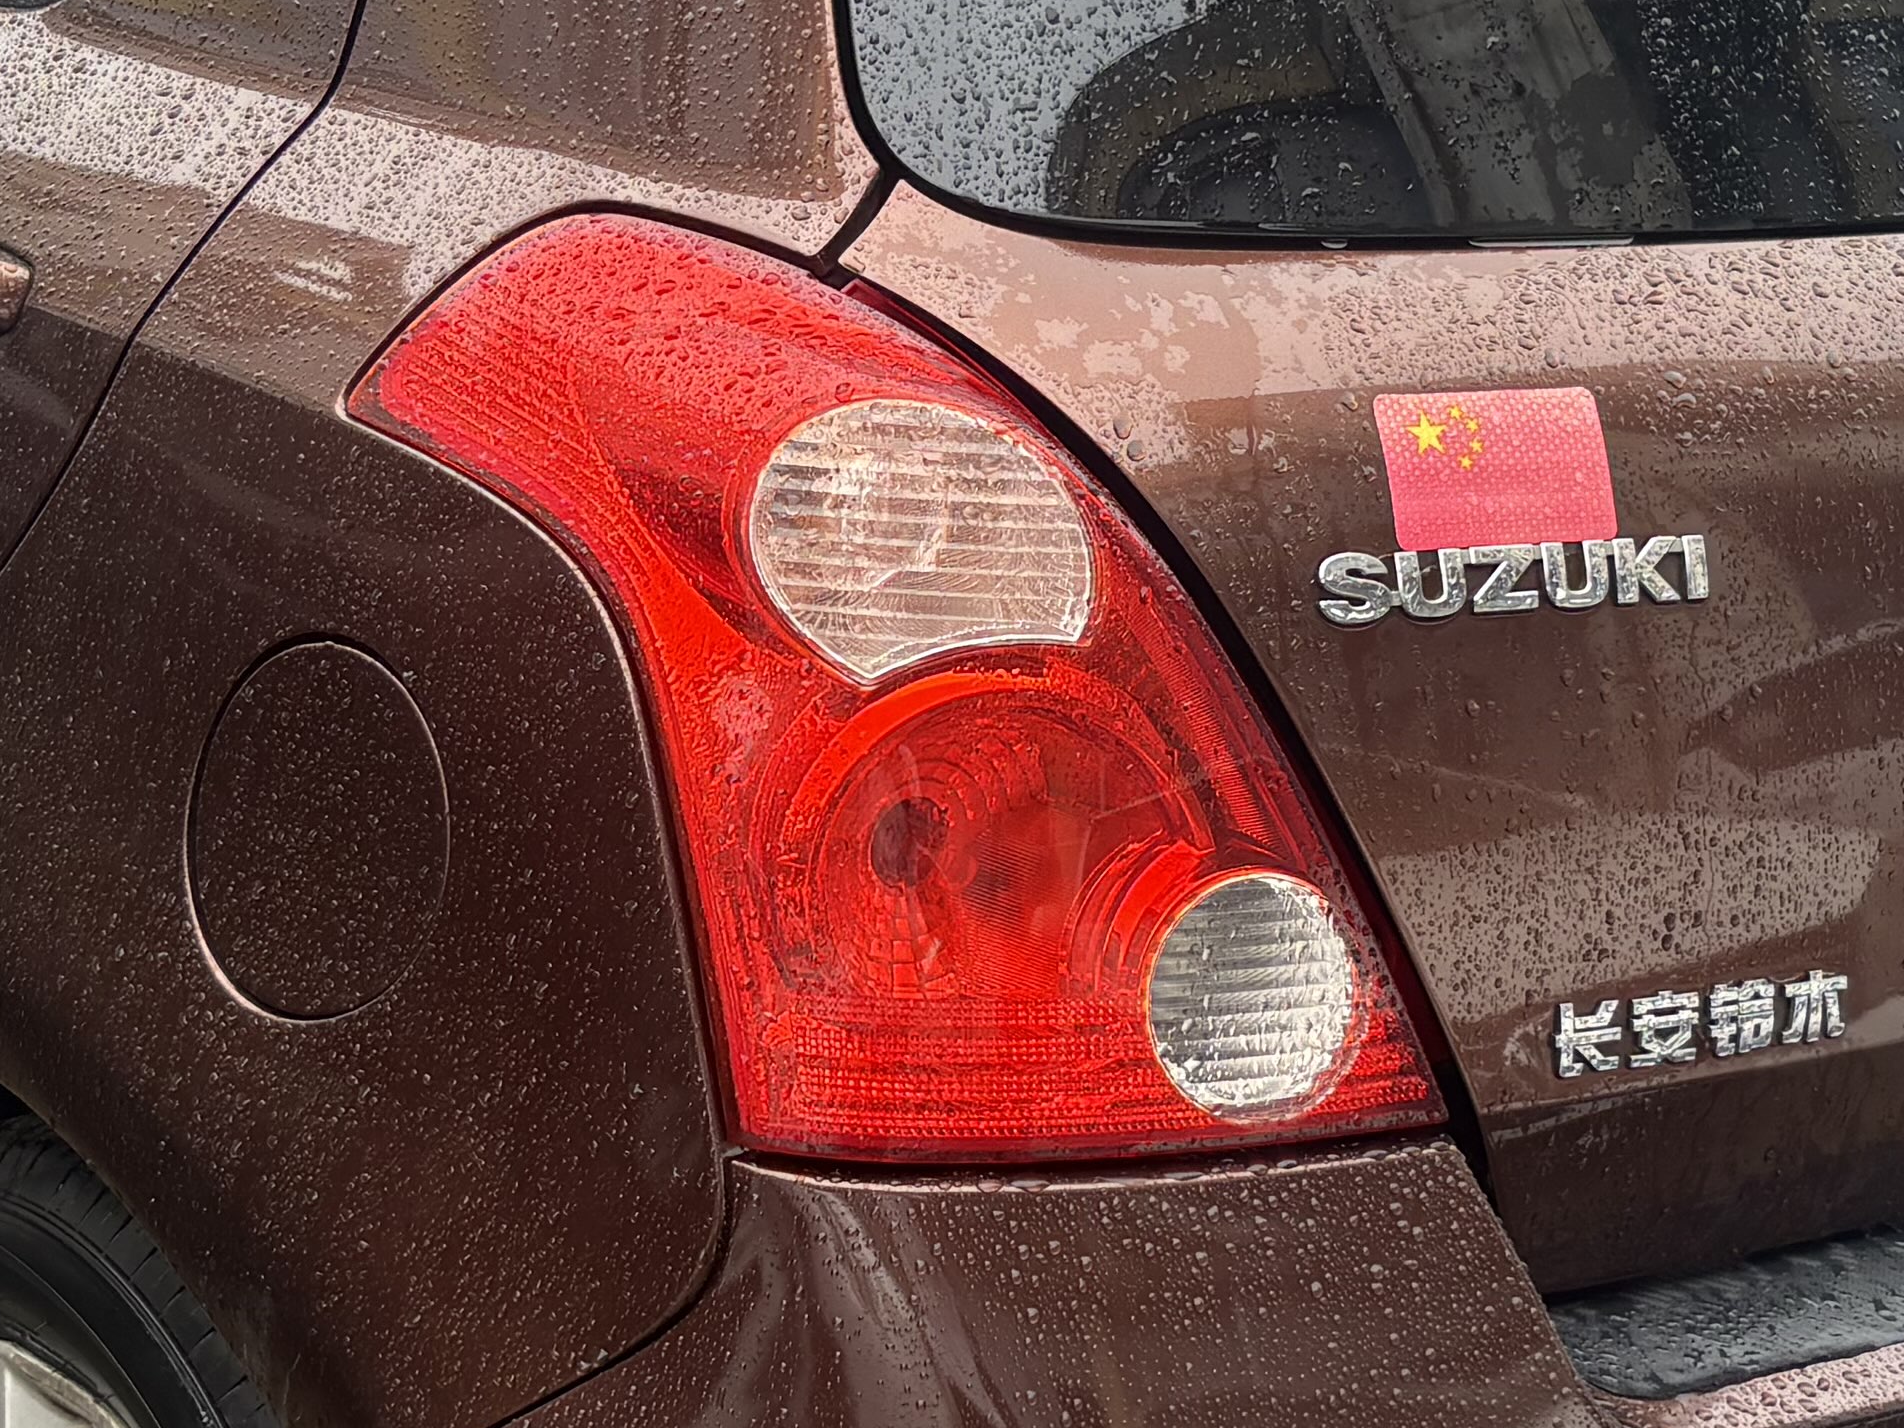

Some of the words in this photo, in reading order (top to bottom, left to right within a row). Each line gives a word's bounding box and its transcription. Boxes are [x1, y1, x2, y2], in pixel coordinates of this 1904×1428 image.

[1316, 533, 1711, 626] SUZUKI
[1552, 968, 1849, 1079] 长安铃木
